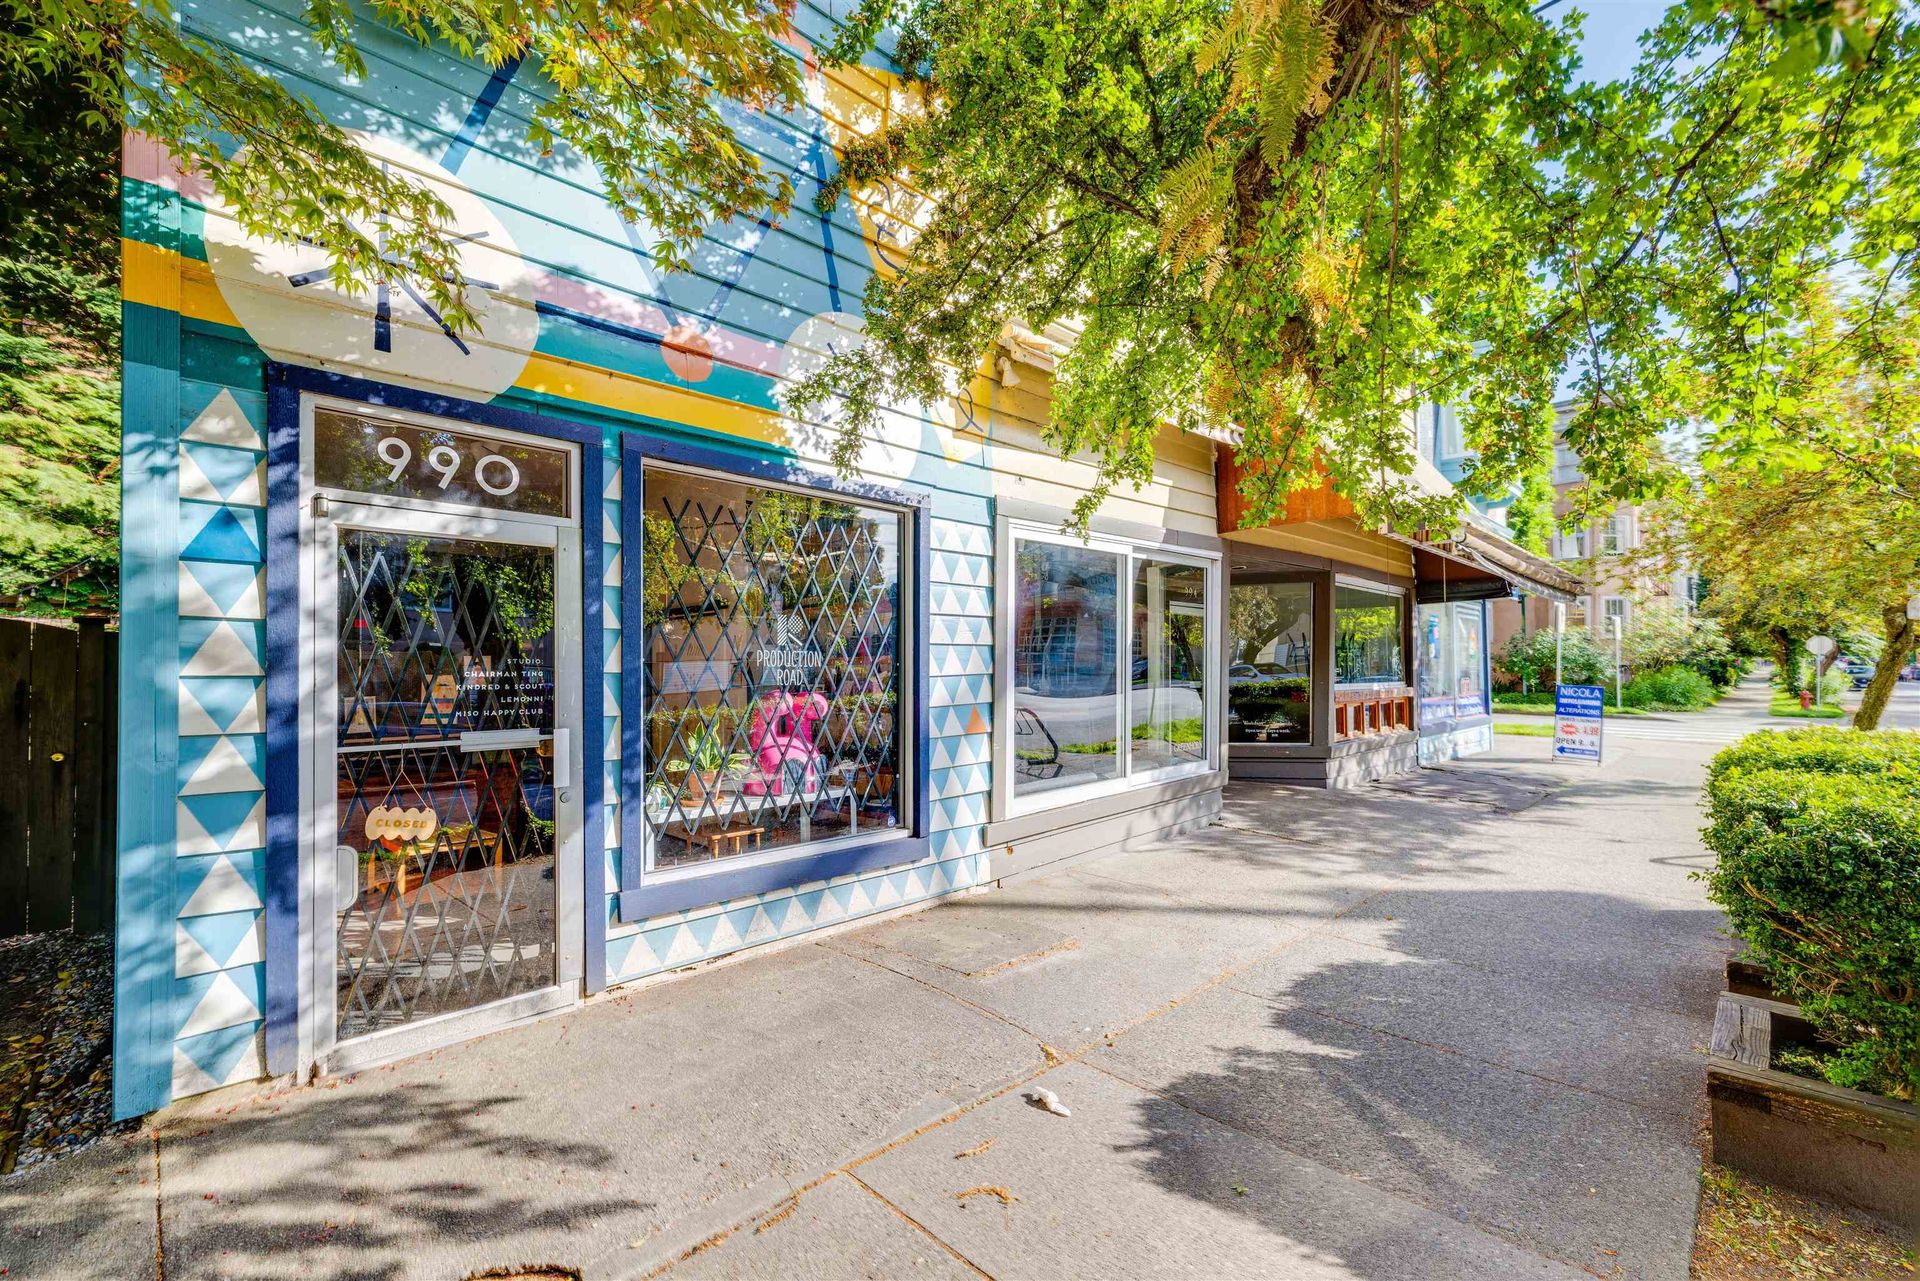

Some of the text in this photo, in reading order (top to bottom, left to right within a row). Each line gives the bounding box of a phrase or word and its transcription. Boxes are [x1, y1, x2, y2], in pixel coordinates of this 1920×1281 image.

[377, 436, 520, 496] 990
[756, 650, 823, 668] PRODUCTION
[776, 669, 803, 686] ROAD
[1560, 687, 1600, 697] NICOLA
[1558, 707, 1601, 715] ALTERATIONS
[375, 818, 428, 829] CLOSED
